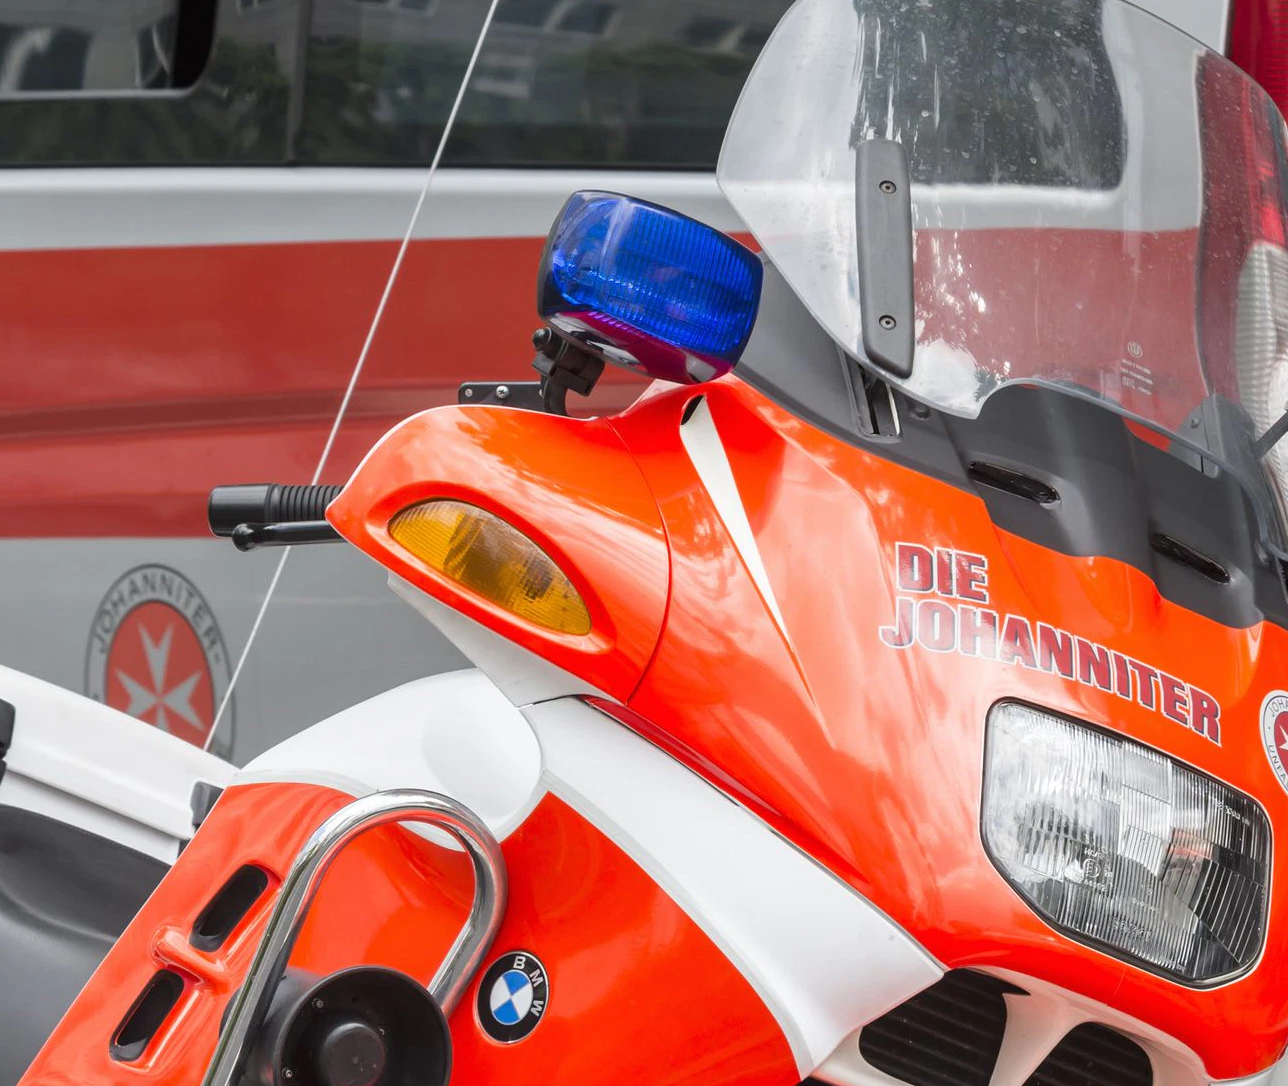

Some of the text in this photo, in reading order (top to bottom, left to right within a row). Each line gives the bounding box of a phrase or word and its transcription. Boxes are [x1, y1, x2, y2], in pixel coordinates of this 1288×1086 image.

[895, 542, 989, 604] DIE
[878, 596, 1222, 747] JOHANNITER
[513, 955, 544, 1017] BMW
